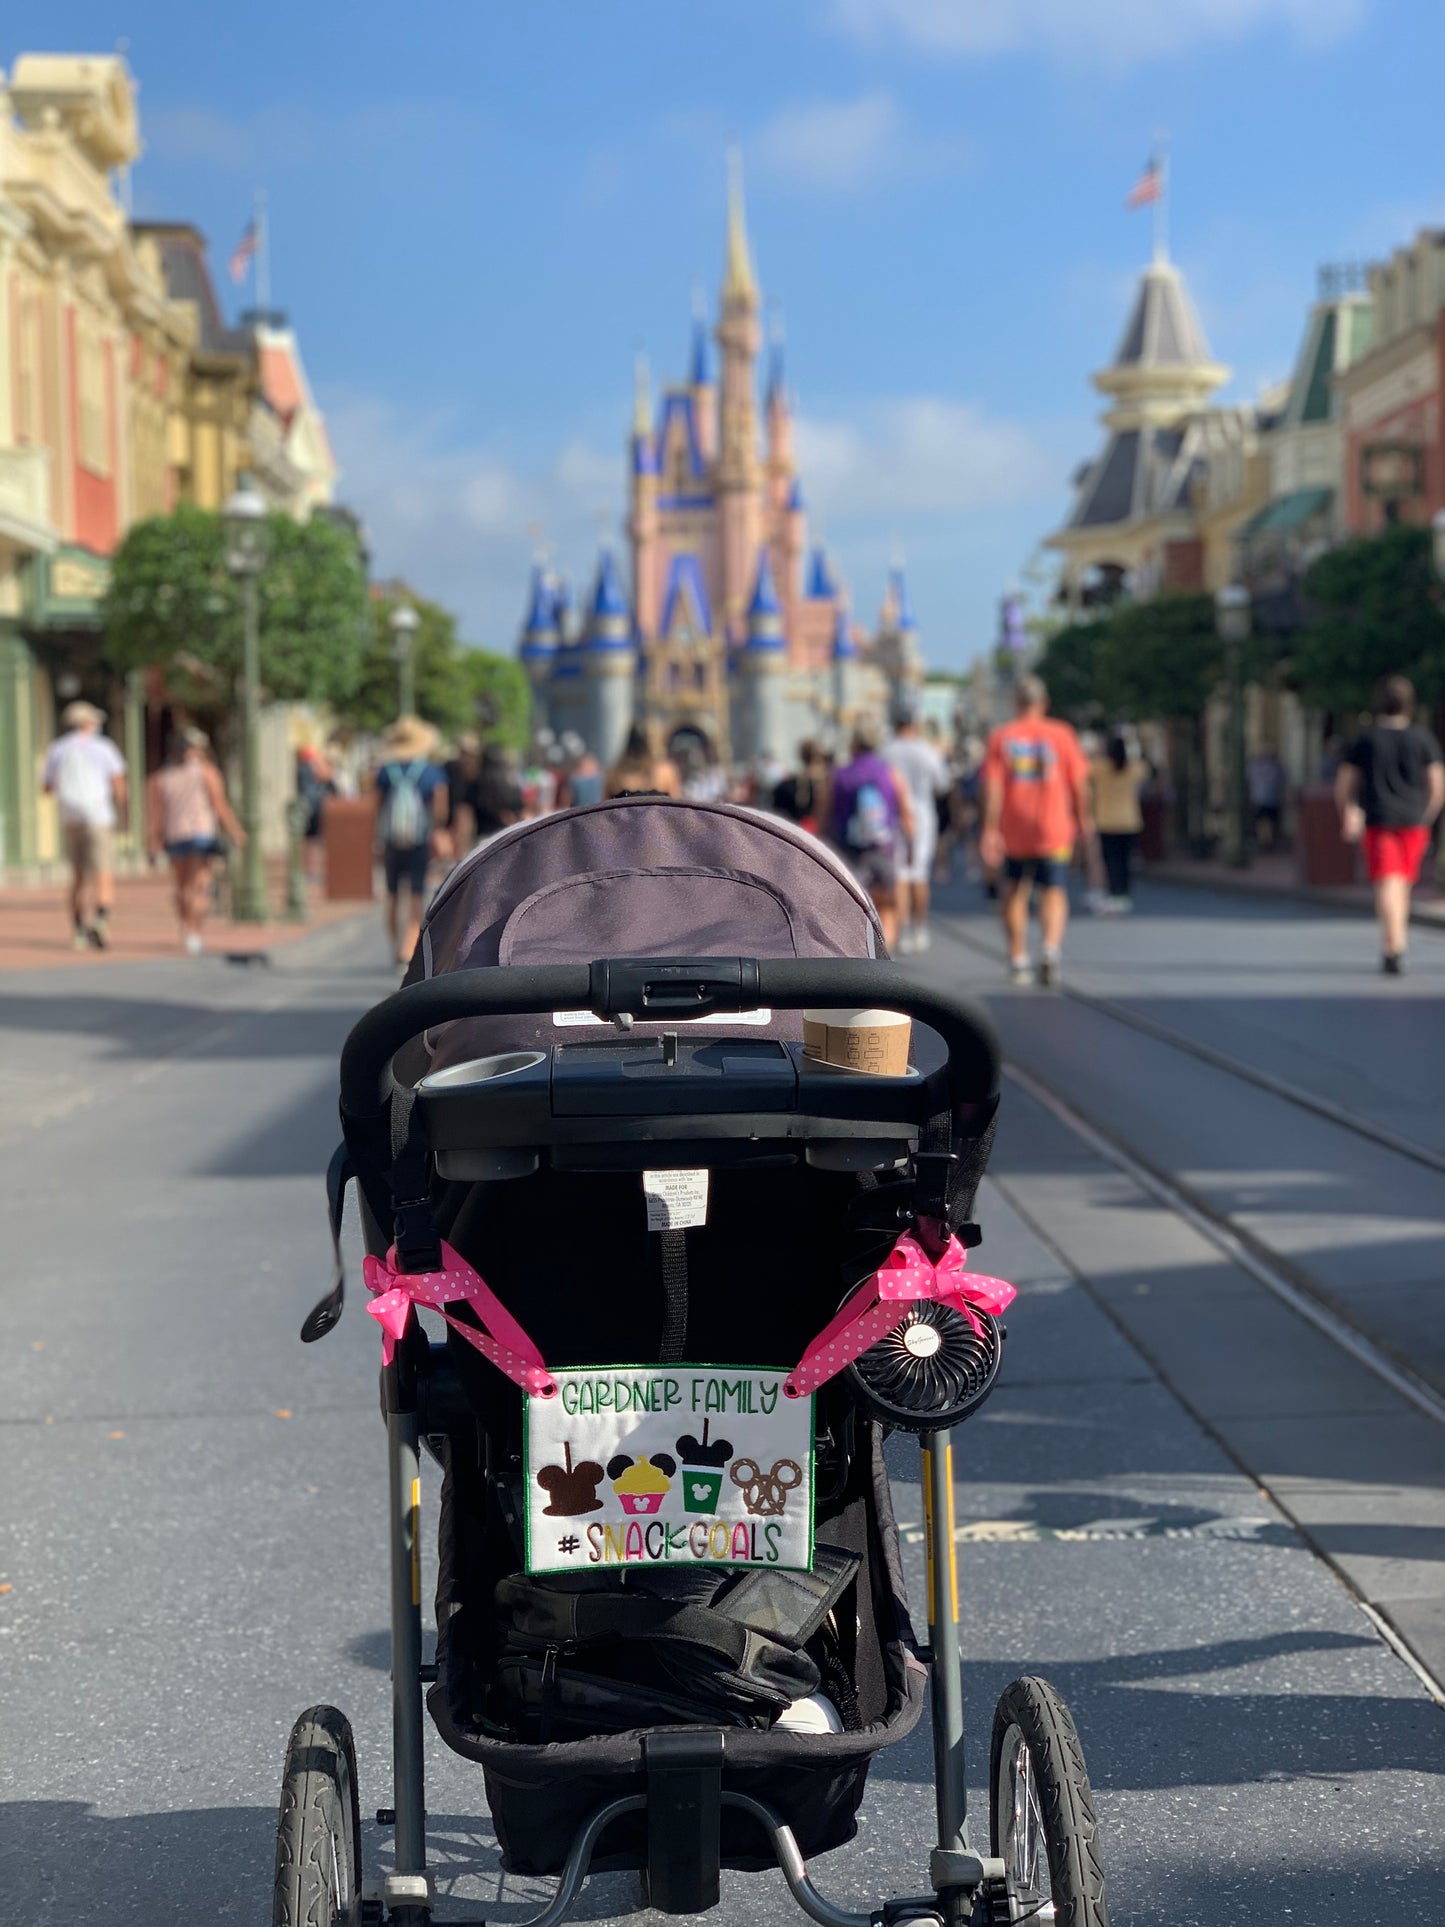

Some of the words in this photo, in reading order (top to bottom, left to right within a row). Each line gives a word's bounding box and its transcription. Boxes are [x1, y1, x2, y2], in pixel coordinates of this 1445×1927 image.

[562, 1378, 682, 1416] GARDNER
[691, 1378, 779, 1415] FAMILY
[905, 1528, 1042, 1543] PEASE
